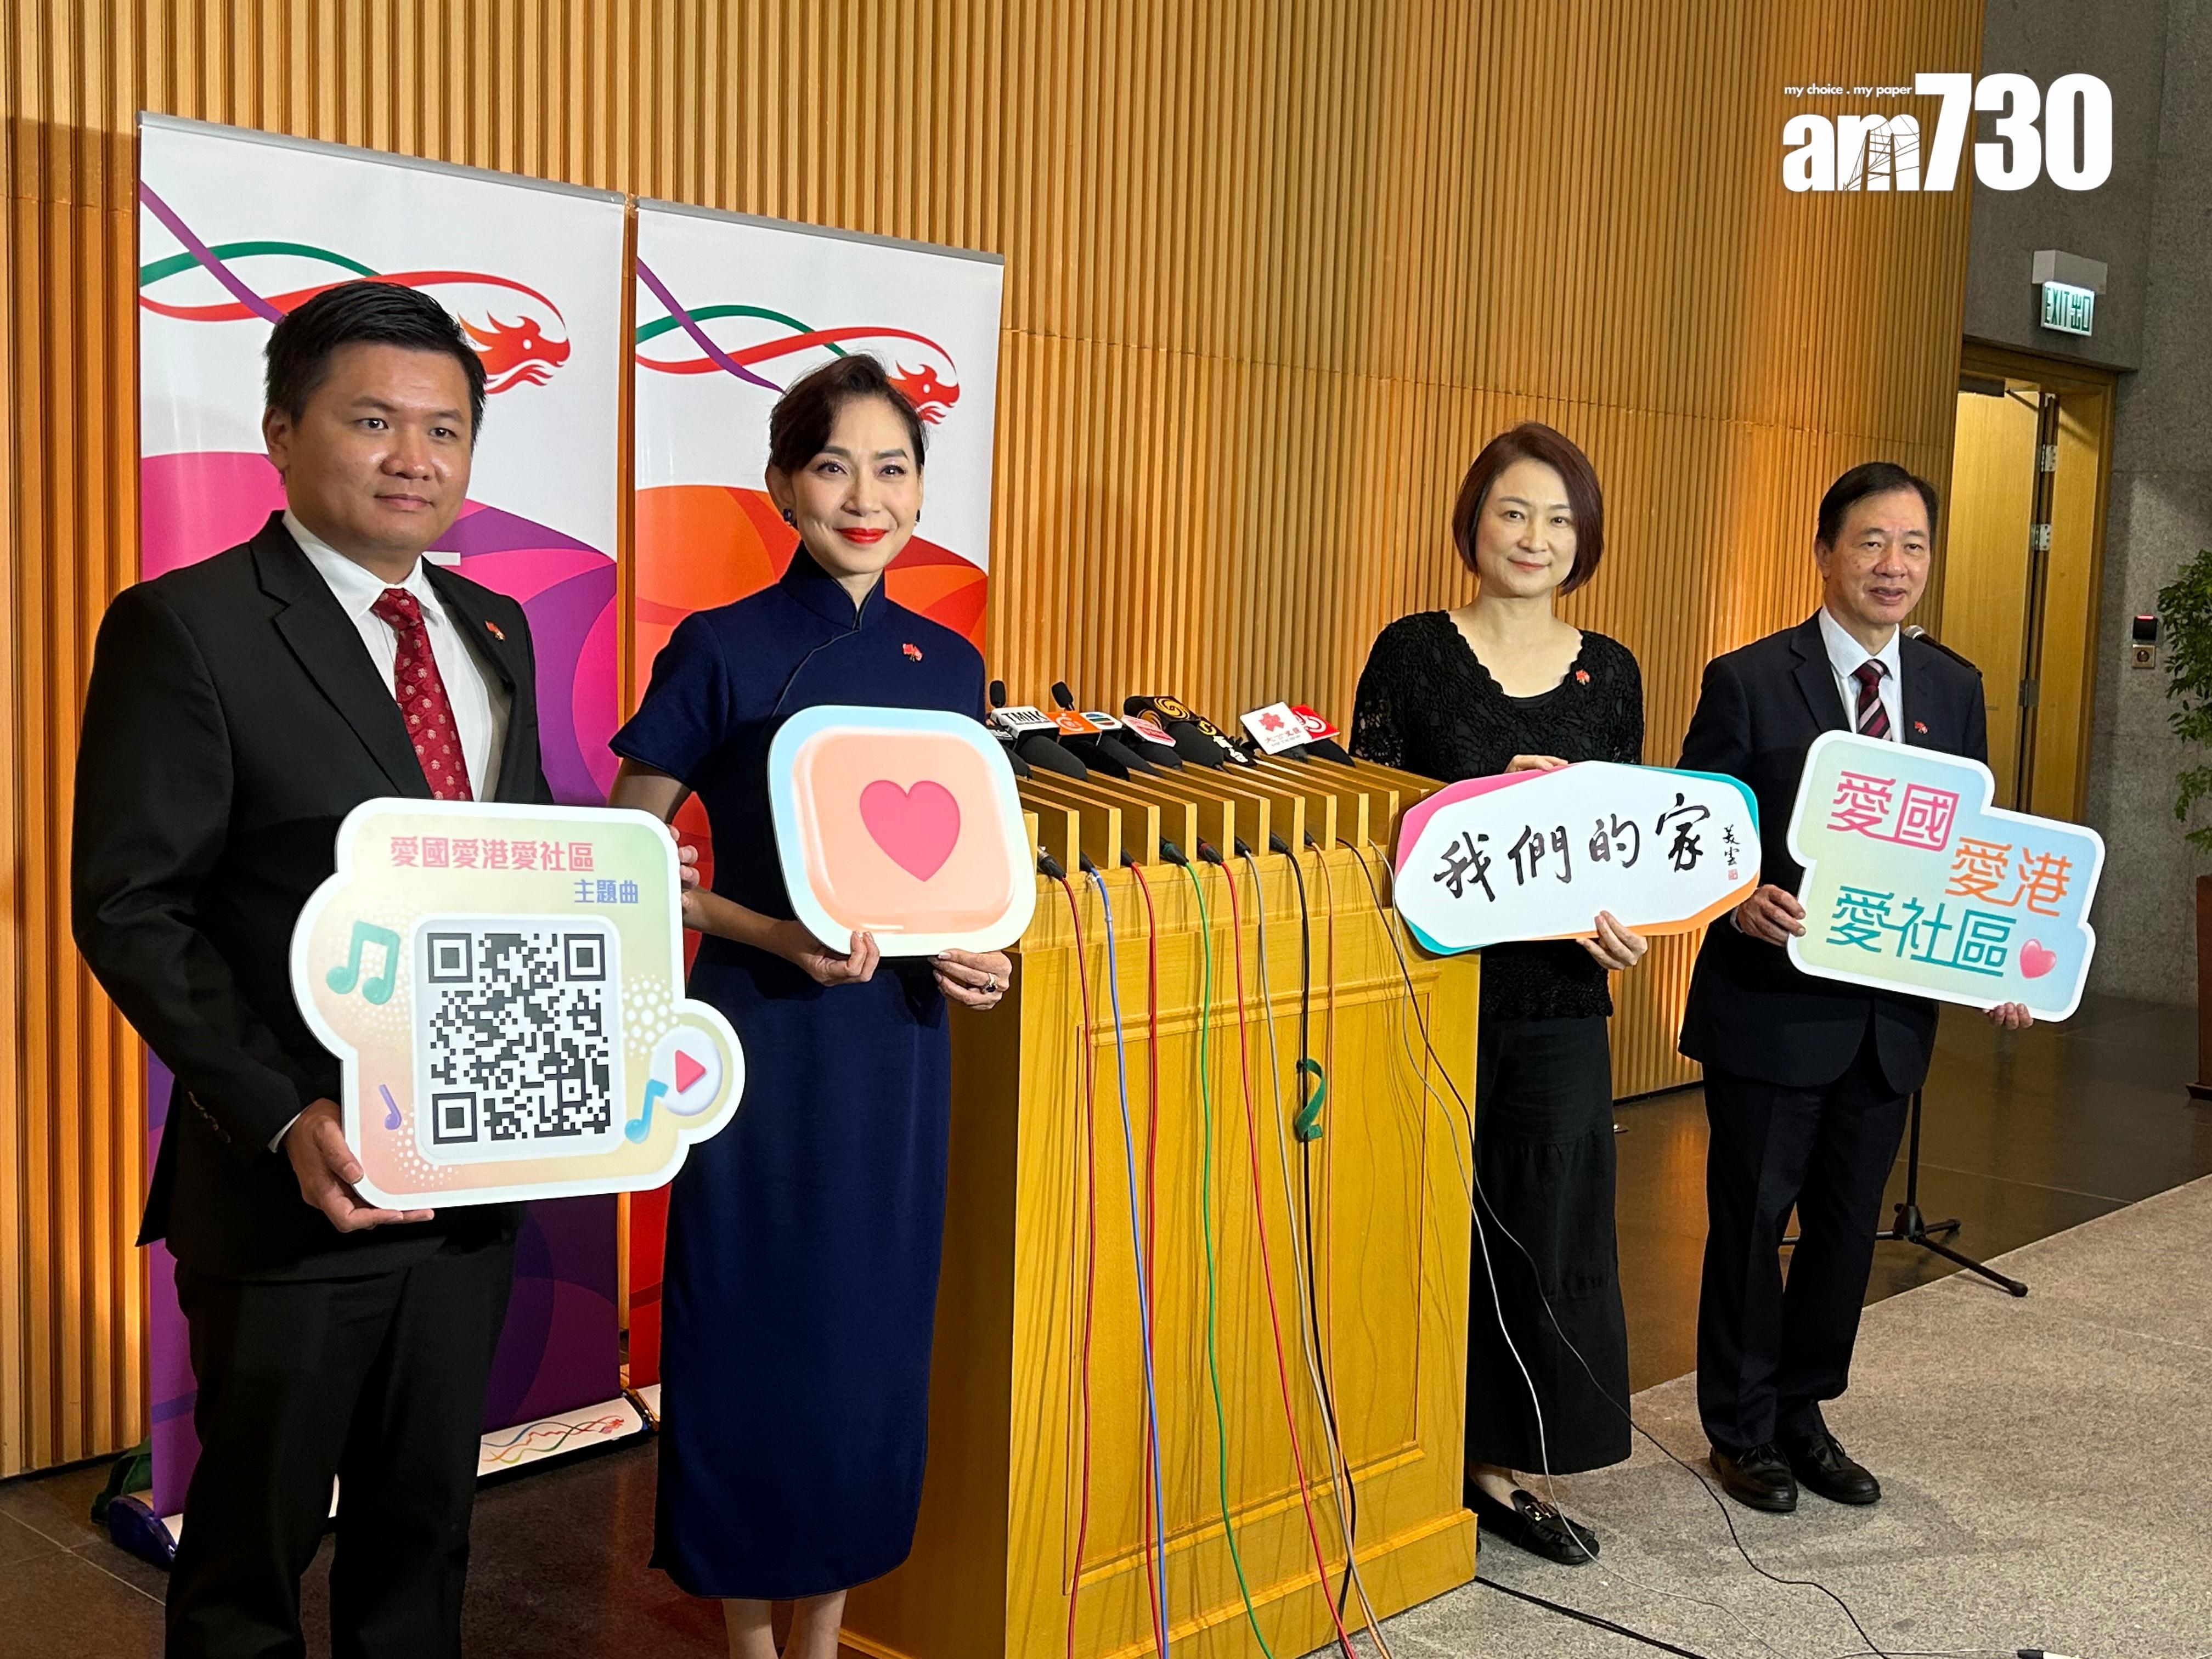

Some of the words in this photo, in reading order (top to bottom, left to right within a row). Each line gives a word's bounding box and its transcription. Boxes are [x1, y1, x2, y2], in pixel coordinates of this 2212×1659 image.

[2045, 287, 2070, 328] EXIT
[2070, 294, 2091, 332] 出口
[1433, 792, 1711, 902] 我們的家
[1826, 770, 1960, 852] 愛國
[390, 835, 595, 872] 愛國愛港愛社區
[573, 879, 639, 905] 主題曲
[1944, 836, 2073, 917] 愛港
[1826, 885, 2017, 978] 愛社區
